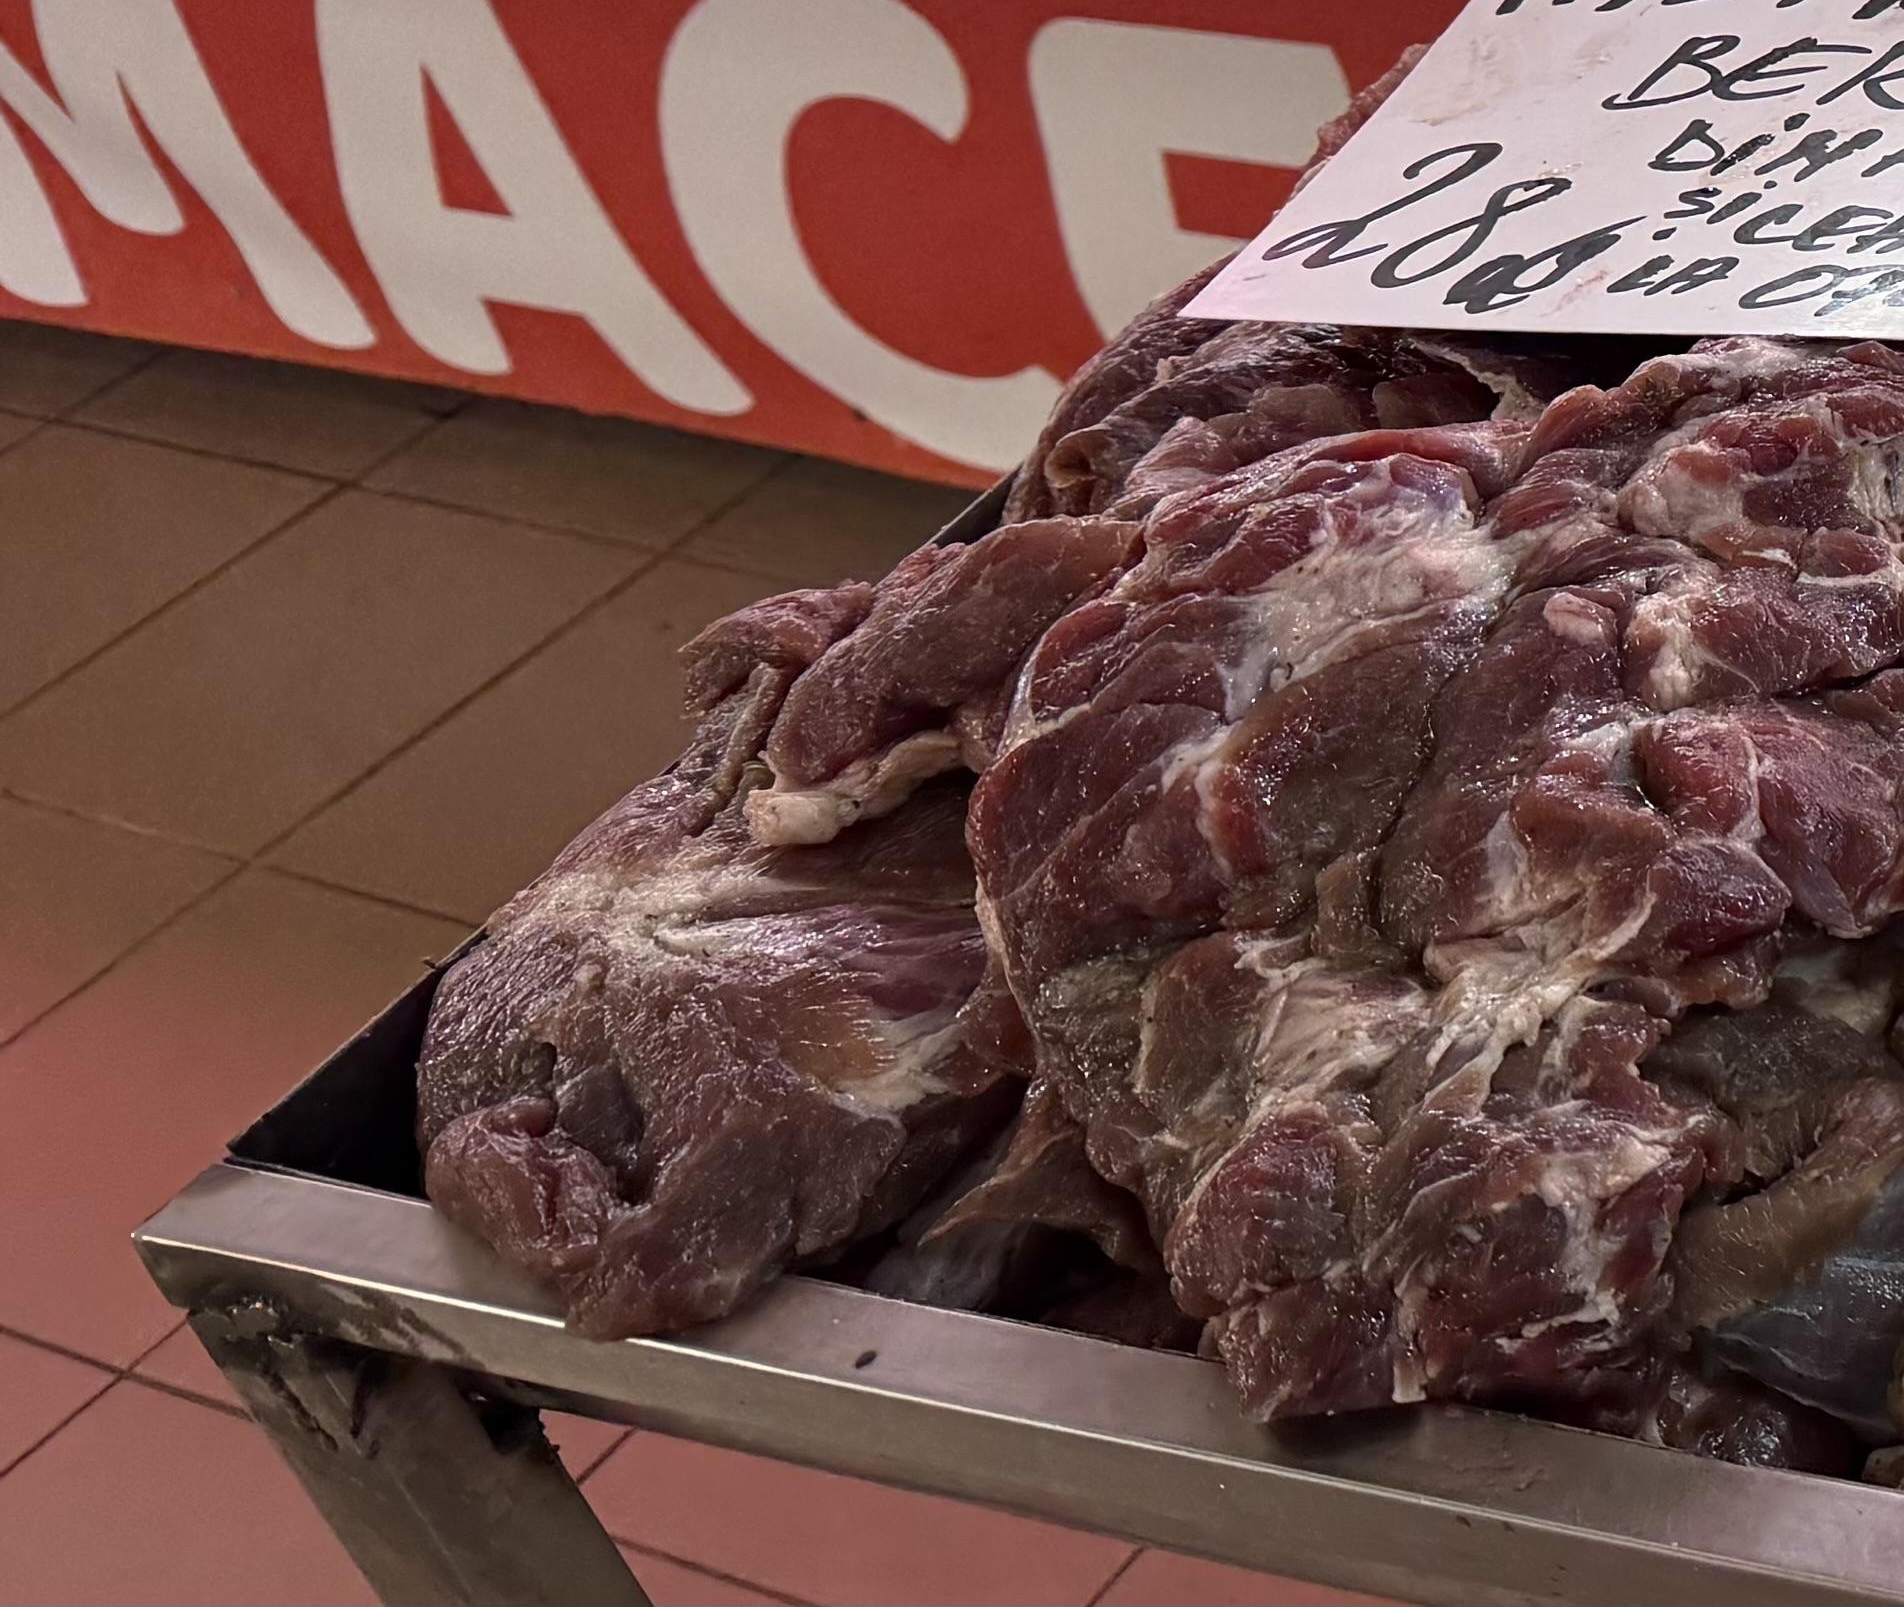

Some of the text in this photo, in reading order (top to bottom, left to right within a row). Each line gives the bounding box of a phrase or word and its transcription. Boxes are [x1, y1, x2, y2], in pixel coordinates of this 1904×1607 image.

[1648, 112, 1883, 183] DIN
[1262, 142, 1575, 289] 28
[1606, 253, 1740, 296] LA
